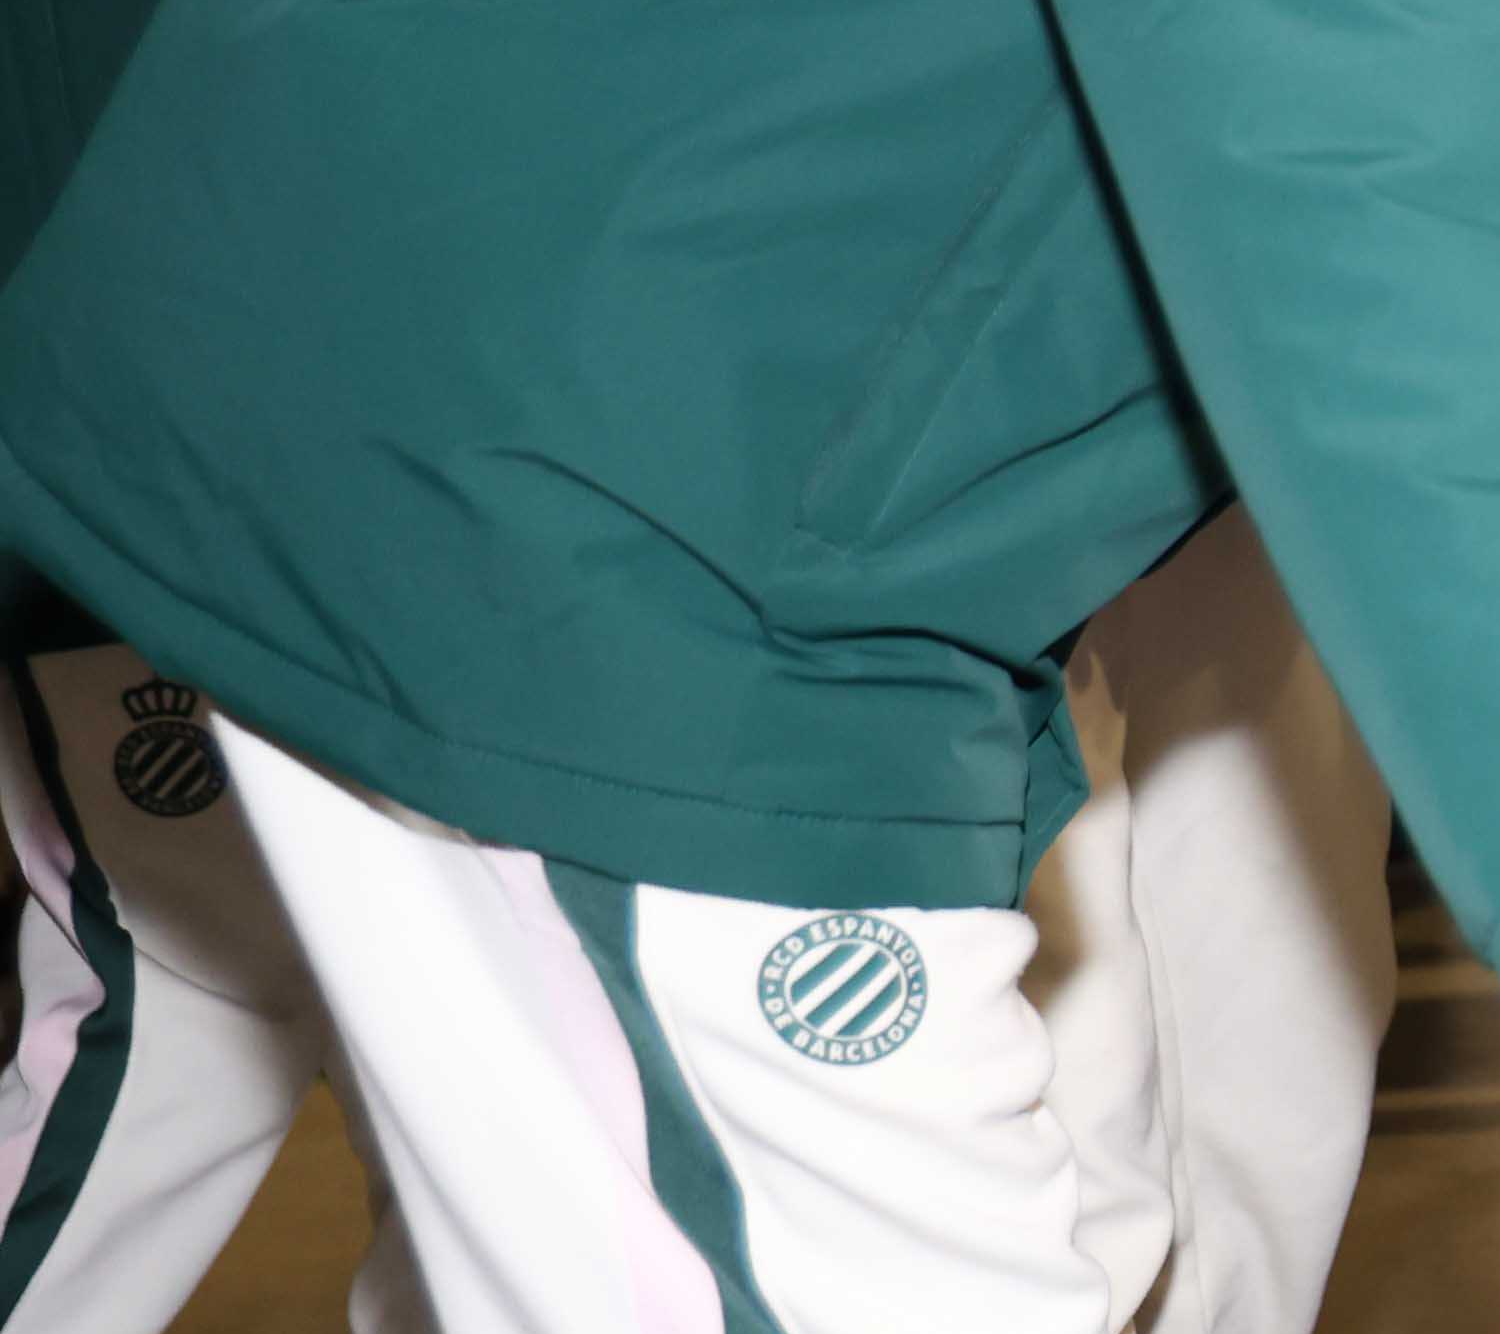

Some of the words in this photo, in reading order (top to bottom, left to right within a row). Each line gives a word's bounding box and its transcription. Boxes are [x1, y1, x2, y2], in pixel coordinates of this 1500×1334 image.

[764, 936, 805, 980] RCD
[810, 917, 922, 978] ESPANYOL
[764, 996, 794, 1030] DE
[793, 995, 924, 1062] BARCELONA
